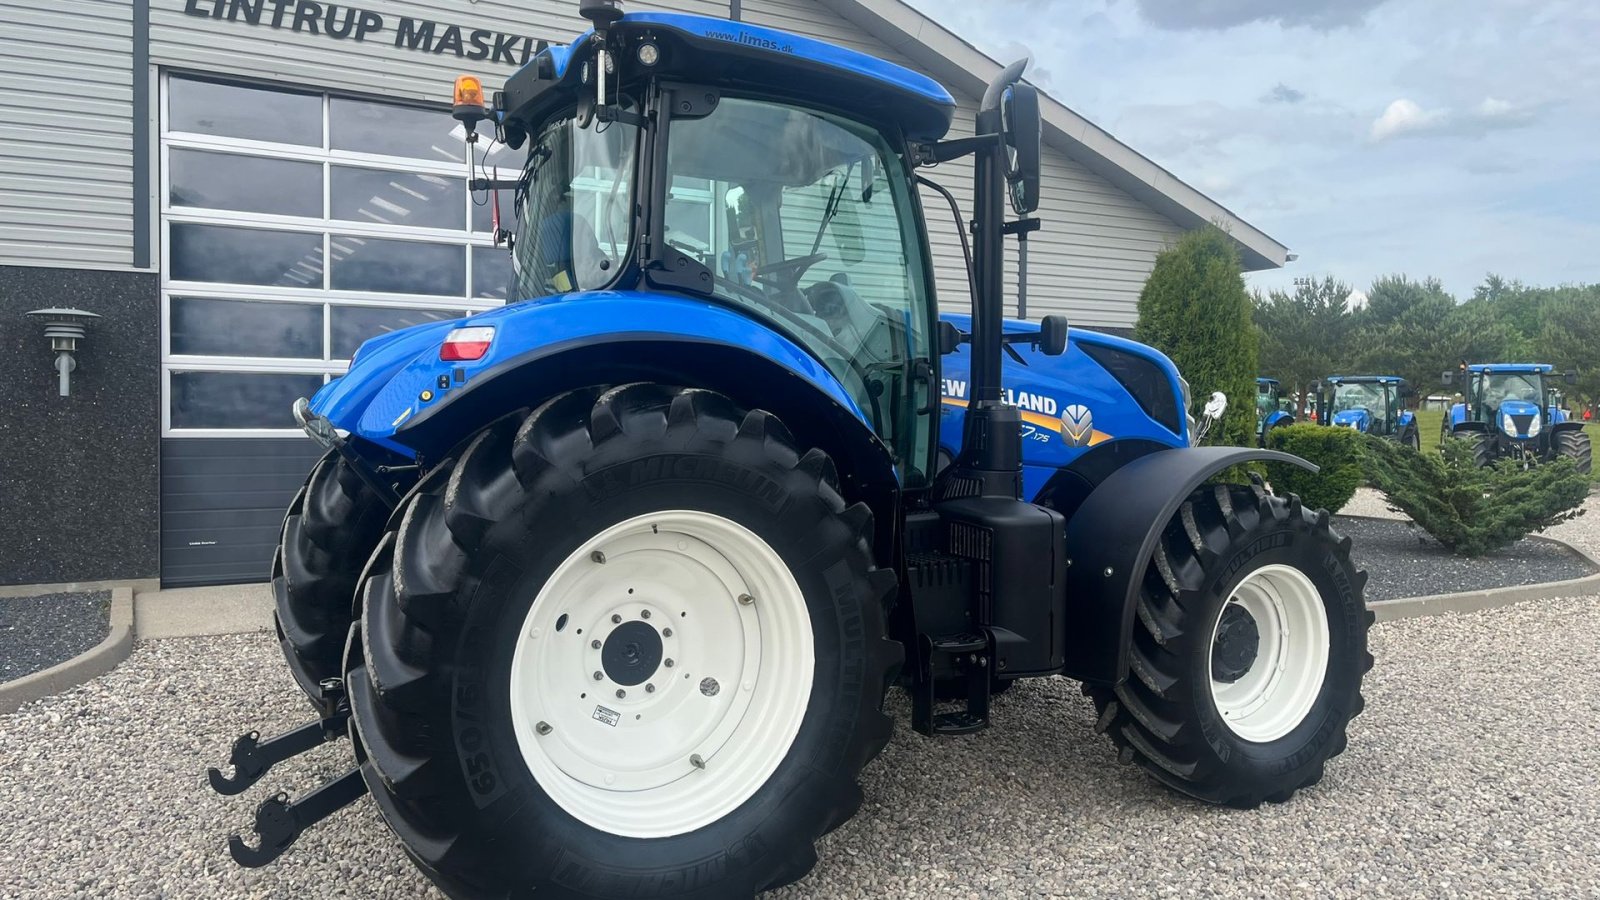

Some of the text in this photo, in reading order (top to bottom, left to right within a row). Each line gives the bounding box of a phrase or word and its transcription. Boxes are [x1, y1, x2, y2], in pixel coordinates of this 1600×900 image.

[185, 0, 384, 42] LINTRUP
[705, 31, 794, 53] www.limas.dk
[941, 379, 966, 397] EW
